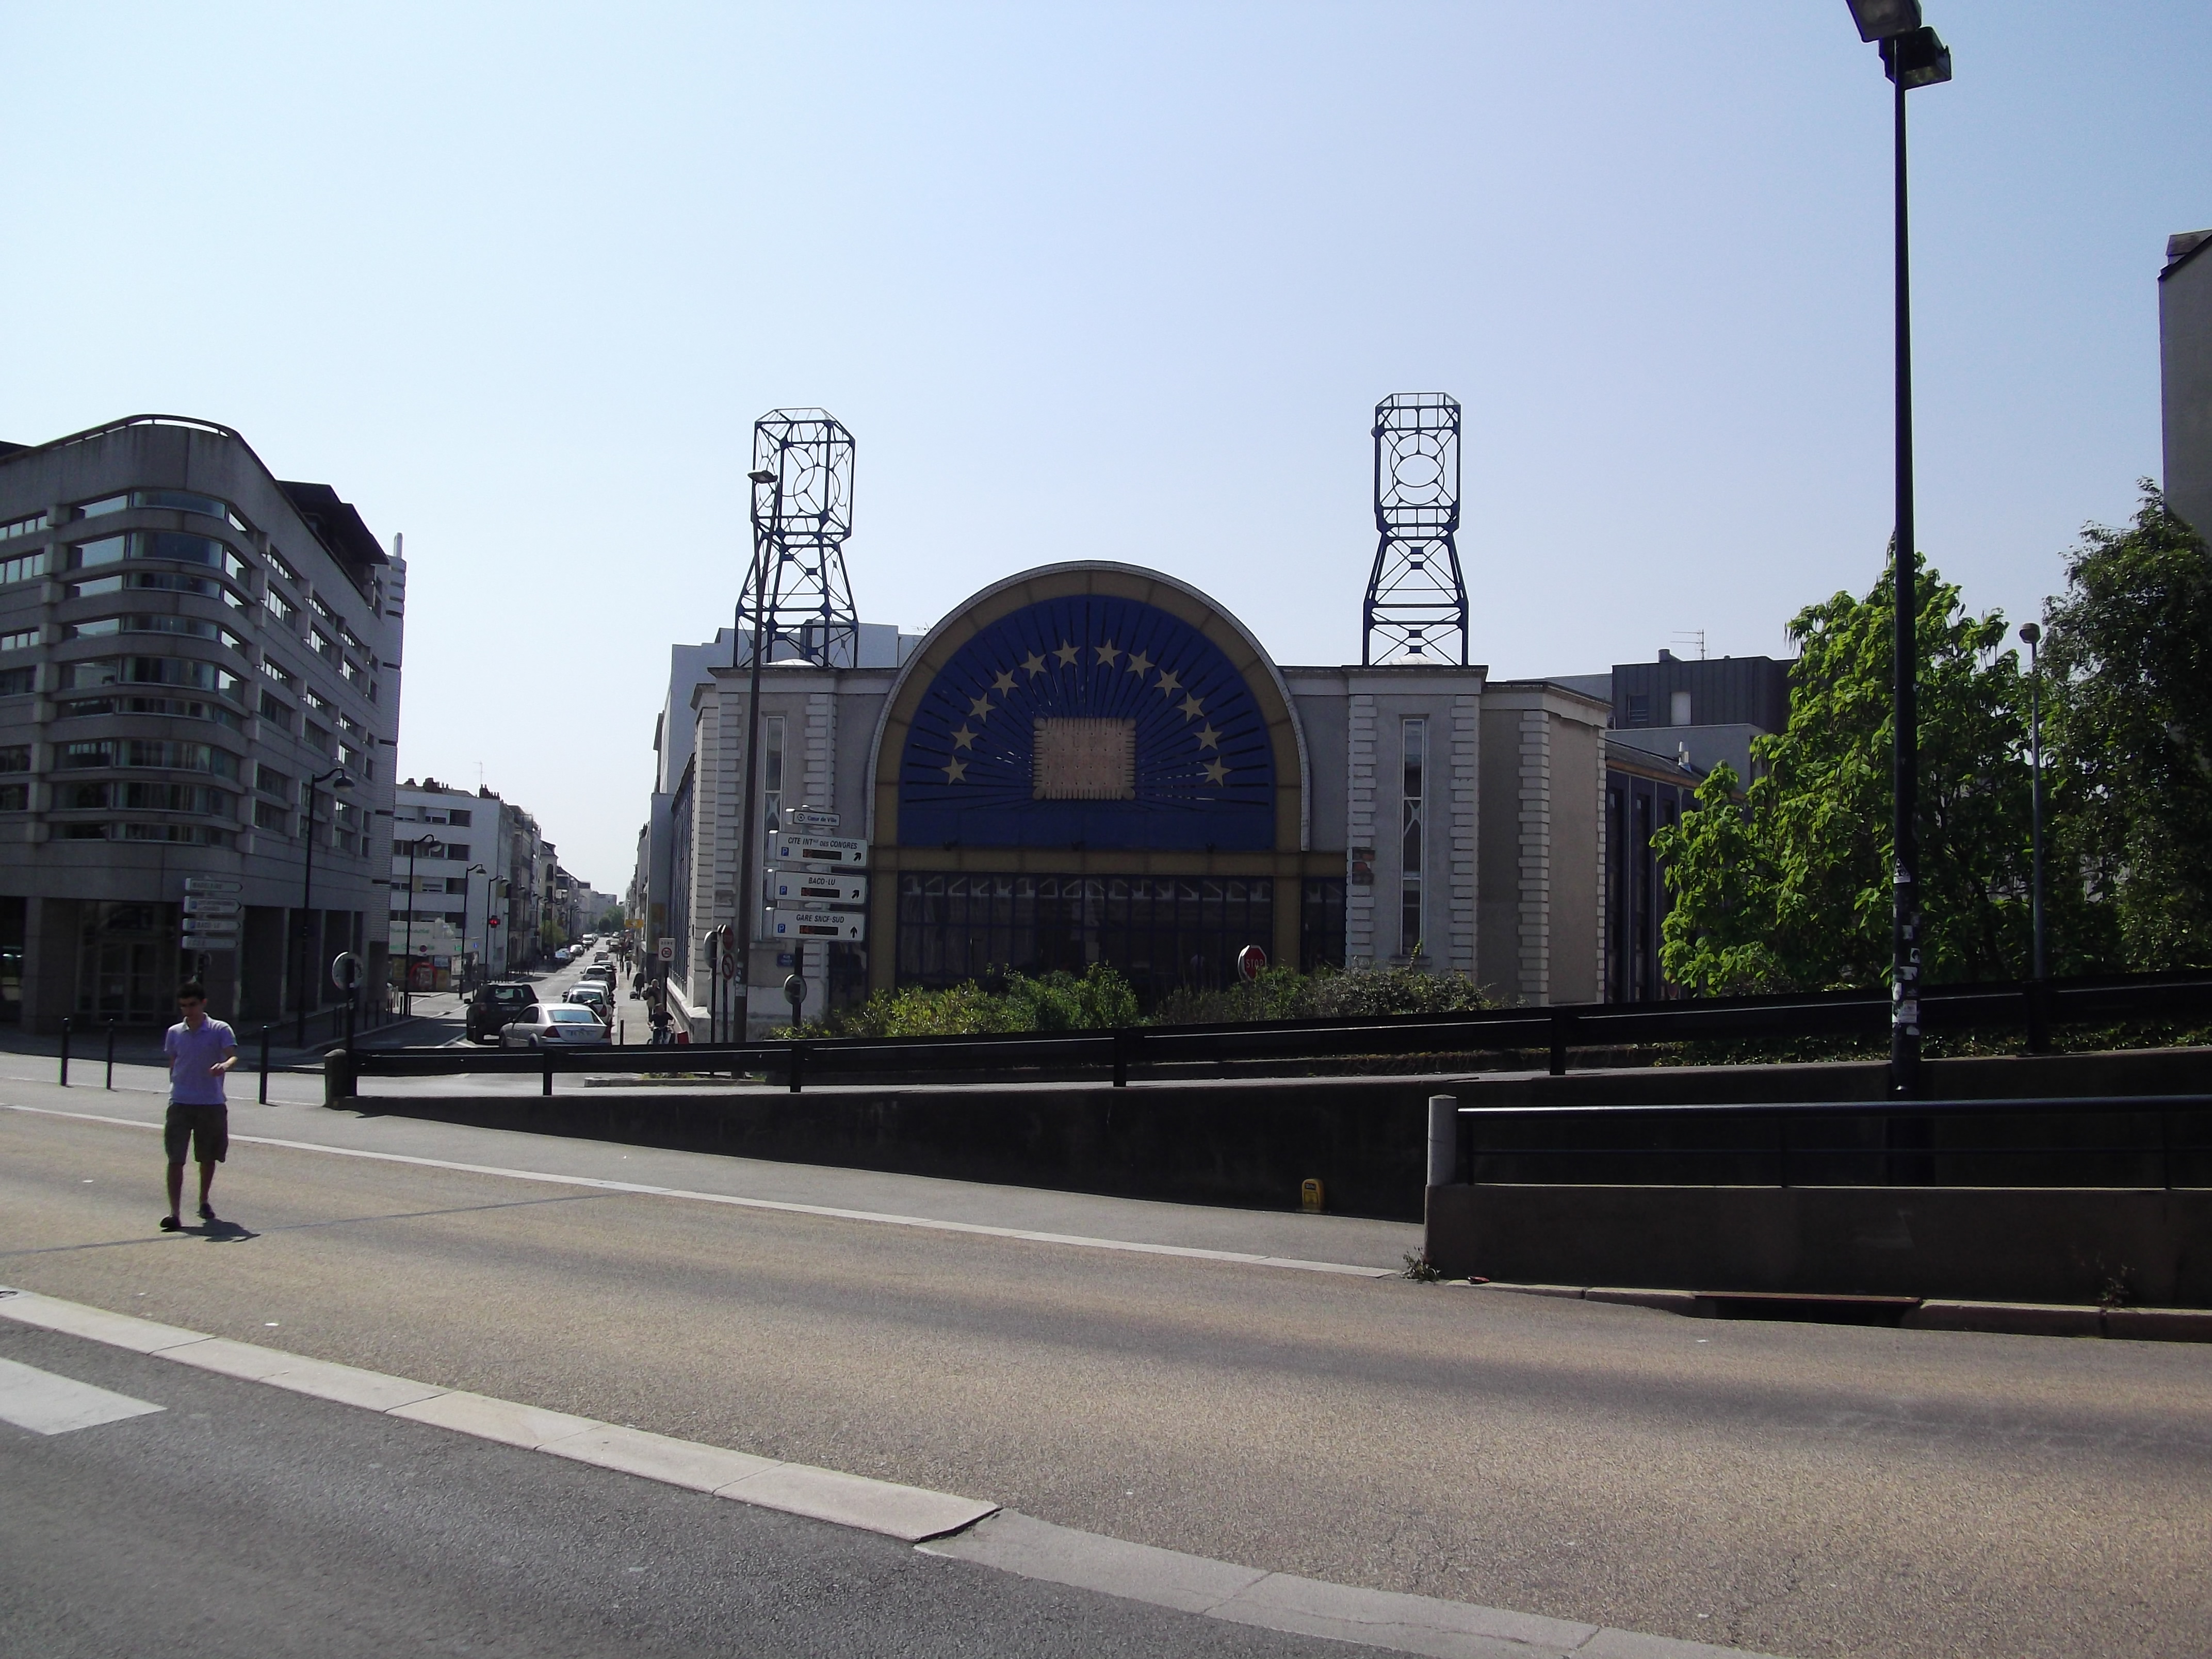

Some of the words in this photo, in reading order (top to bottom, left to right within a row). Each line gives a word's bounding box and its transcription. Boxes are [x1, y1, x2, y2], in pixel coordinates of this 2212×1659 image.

[830, 840, 858, 850] CONGRES
[808, 877, 836, 885] BACO-LU
[1246, 958, 1263, 968] STOP
